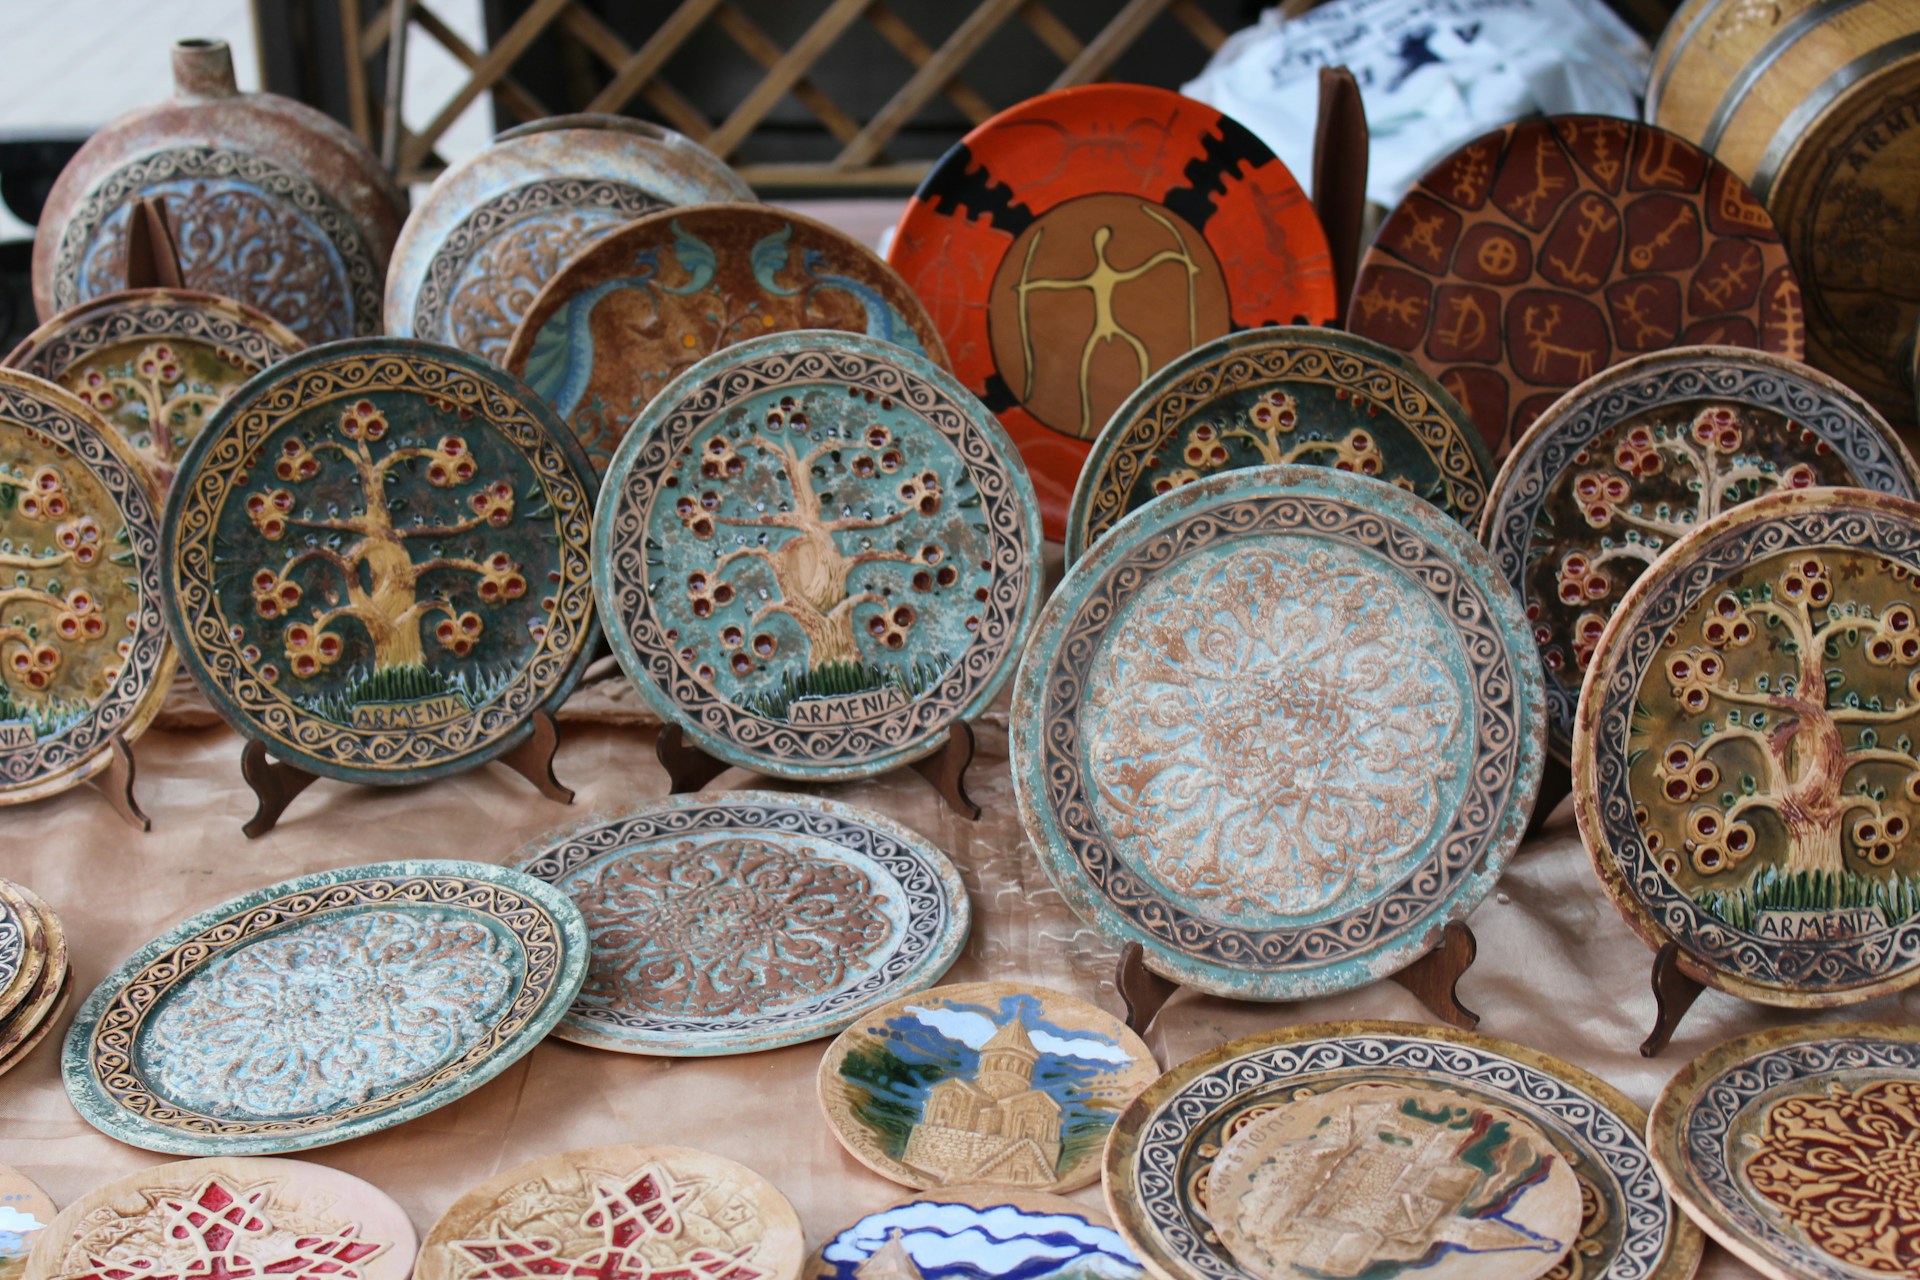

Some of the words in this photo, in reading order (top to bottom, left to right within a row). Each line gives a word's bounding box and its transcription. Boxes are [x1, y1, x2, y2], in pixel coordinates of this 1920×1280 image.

[356, 697, 466, 728] ARMENIA
[793, 689, 902, 723] ARMENIA
[1760, 911, 1883, 940] ARMENIA
